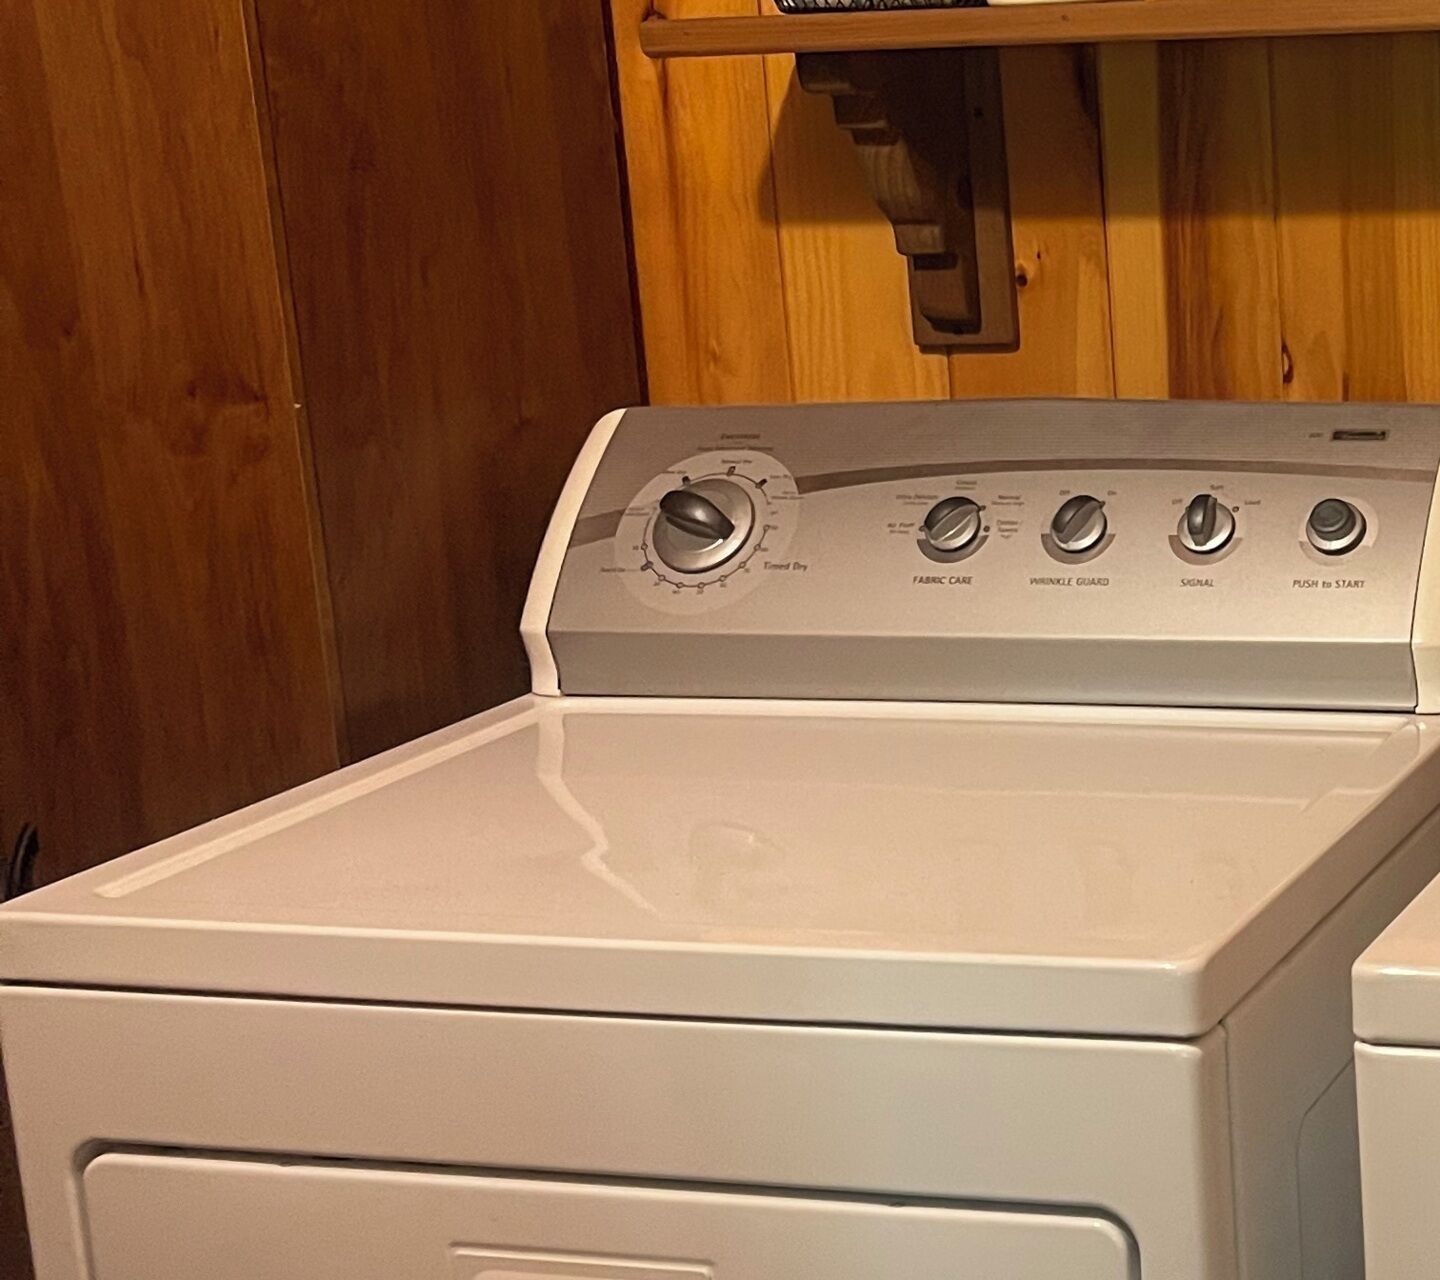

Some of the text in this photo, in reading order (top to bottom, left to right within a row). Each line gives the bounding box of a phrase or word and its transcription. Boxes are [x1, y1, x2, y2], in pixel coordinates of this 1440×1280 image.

[764, 561, 791, 571] Timed
[793, 561, 808, 573] Dry
[913, 576, 973, 585] FABRIC CARE
[1029, 578, 1110, 587] WRINKLE GUARD
[1180, 579, 1215, 588] SIGNAL
[1292, 580, 1365, 589] PUSH to START
